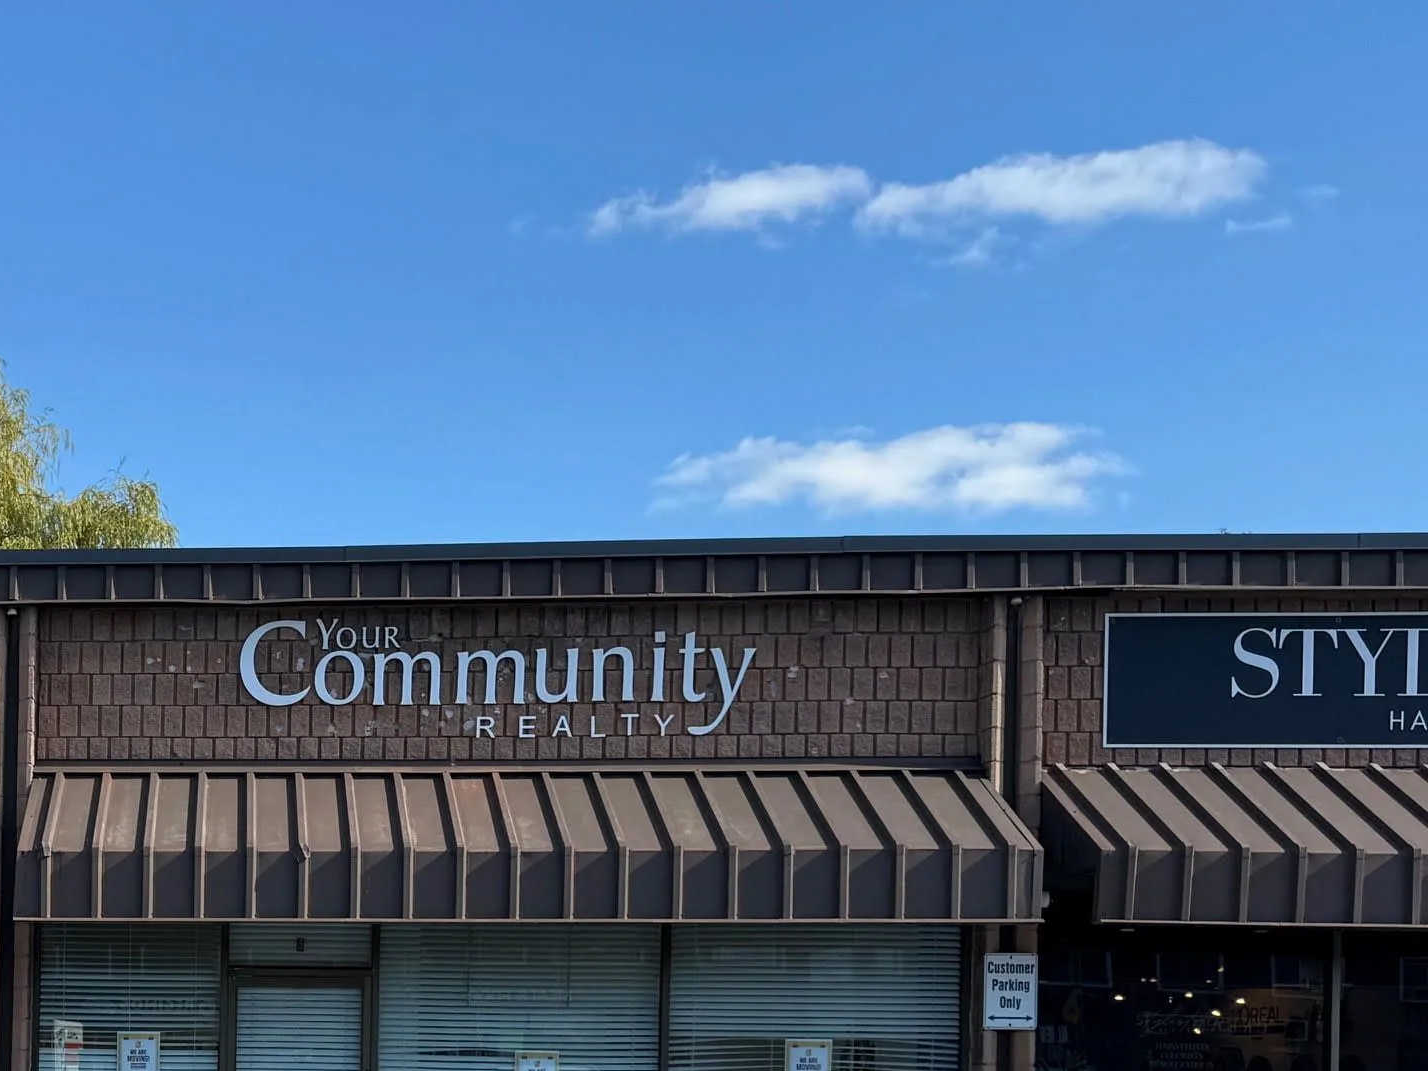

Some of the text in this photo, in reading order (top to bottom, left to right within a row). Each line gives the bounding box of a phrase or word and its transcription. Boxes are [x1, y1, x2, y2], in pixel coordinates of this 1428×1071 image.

[315, 618, 401, 650] YOUR
[239, 619, 757, 736] Community
[475, 714, 675, 739] REALTY
[987, 961, 1035, 974] Customer
[992, 978, 1030, 993] Parking
[999, 996, 1022, 1010] Only
